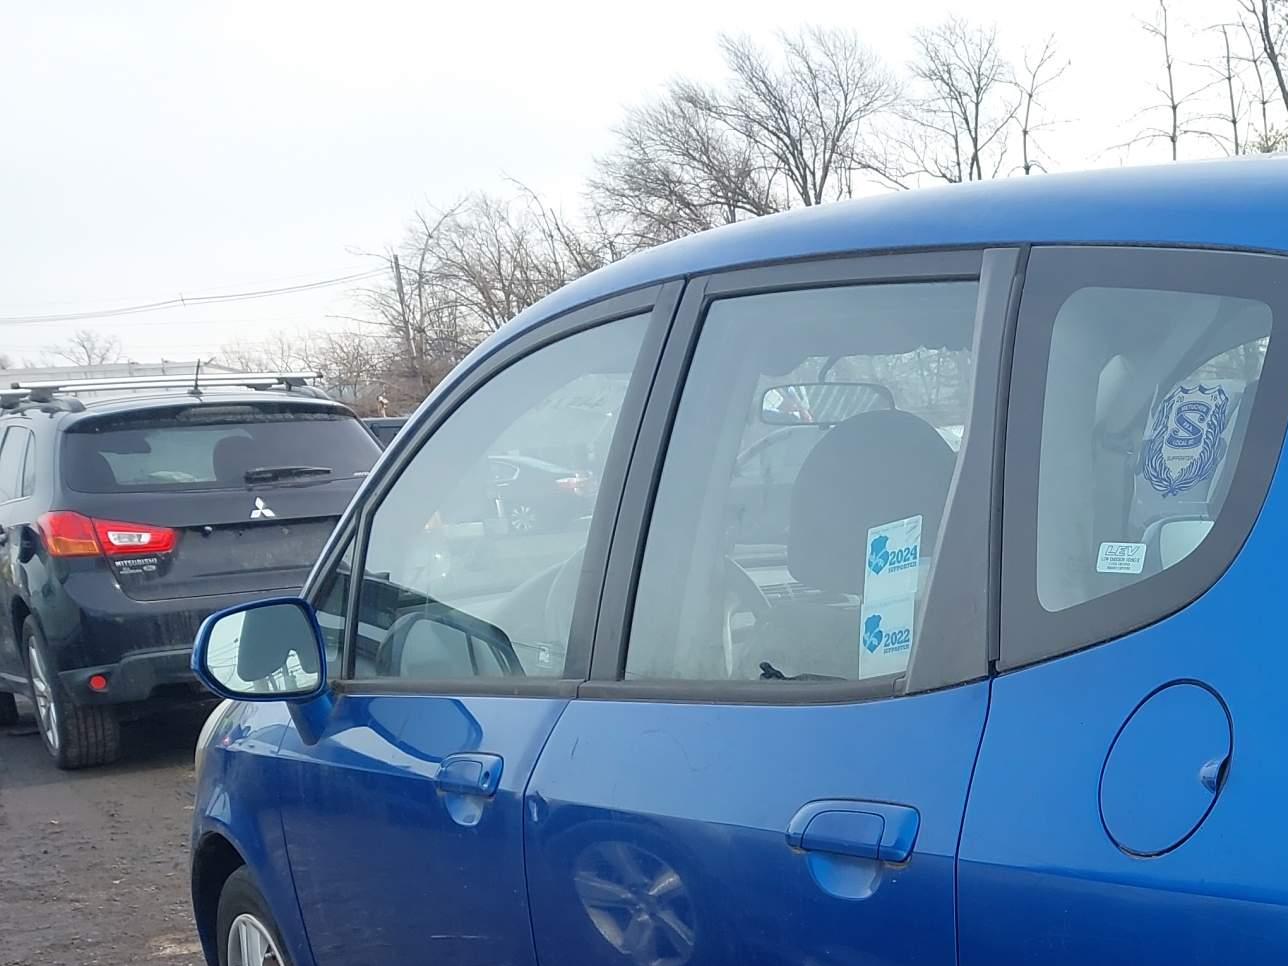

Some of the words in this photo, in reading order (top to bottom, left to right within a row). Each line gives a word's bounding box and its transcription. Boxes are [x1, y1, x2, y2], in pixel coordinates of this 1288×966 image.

[888, 544, 918, 566] 2024
[1104, 545, 1140, 556] LEV
[883, 628, 910, 648] 2022
